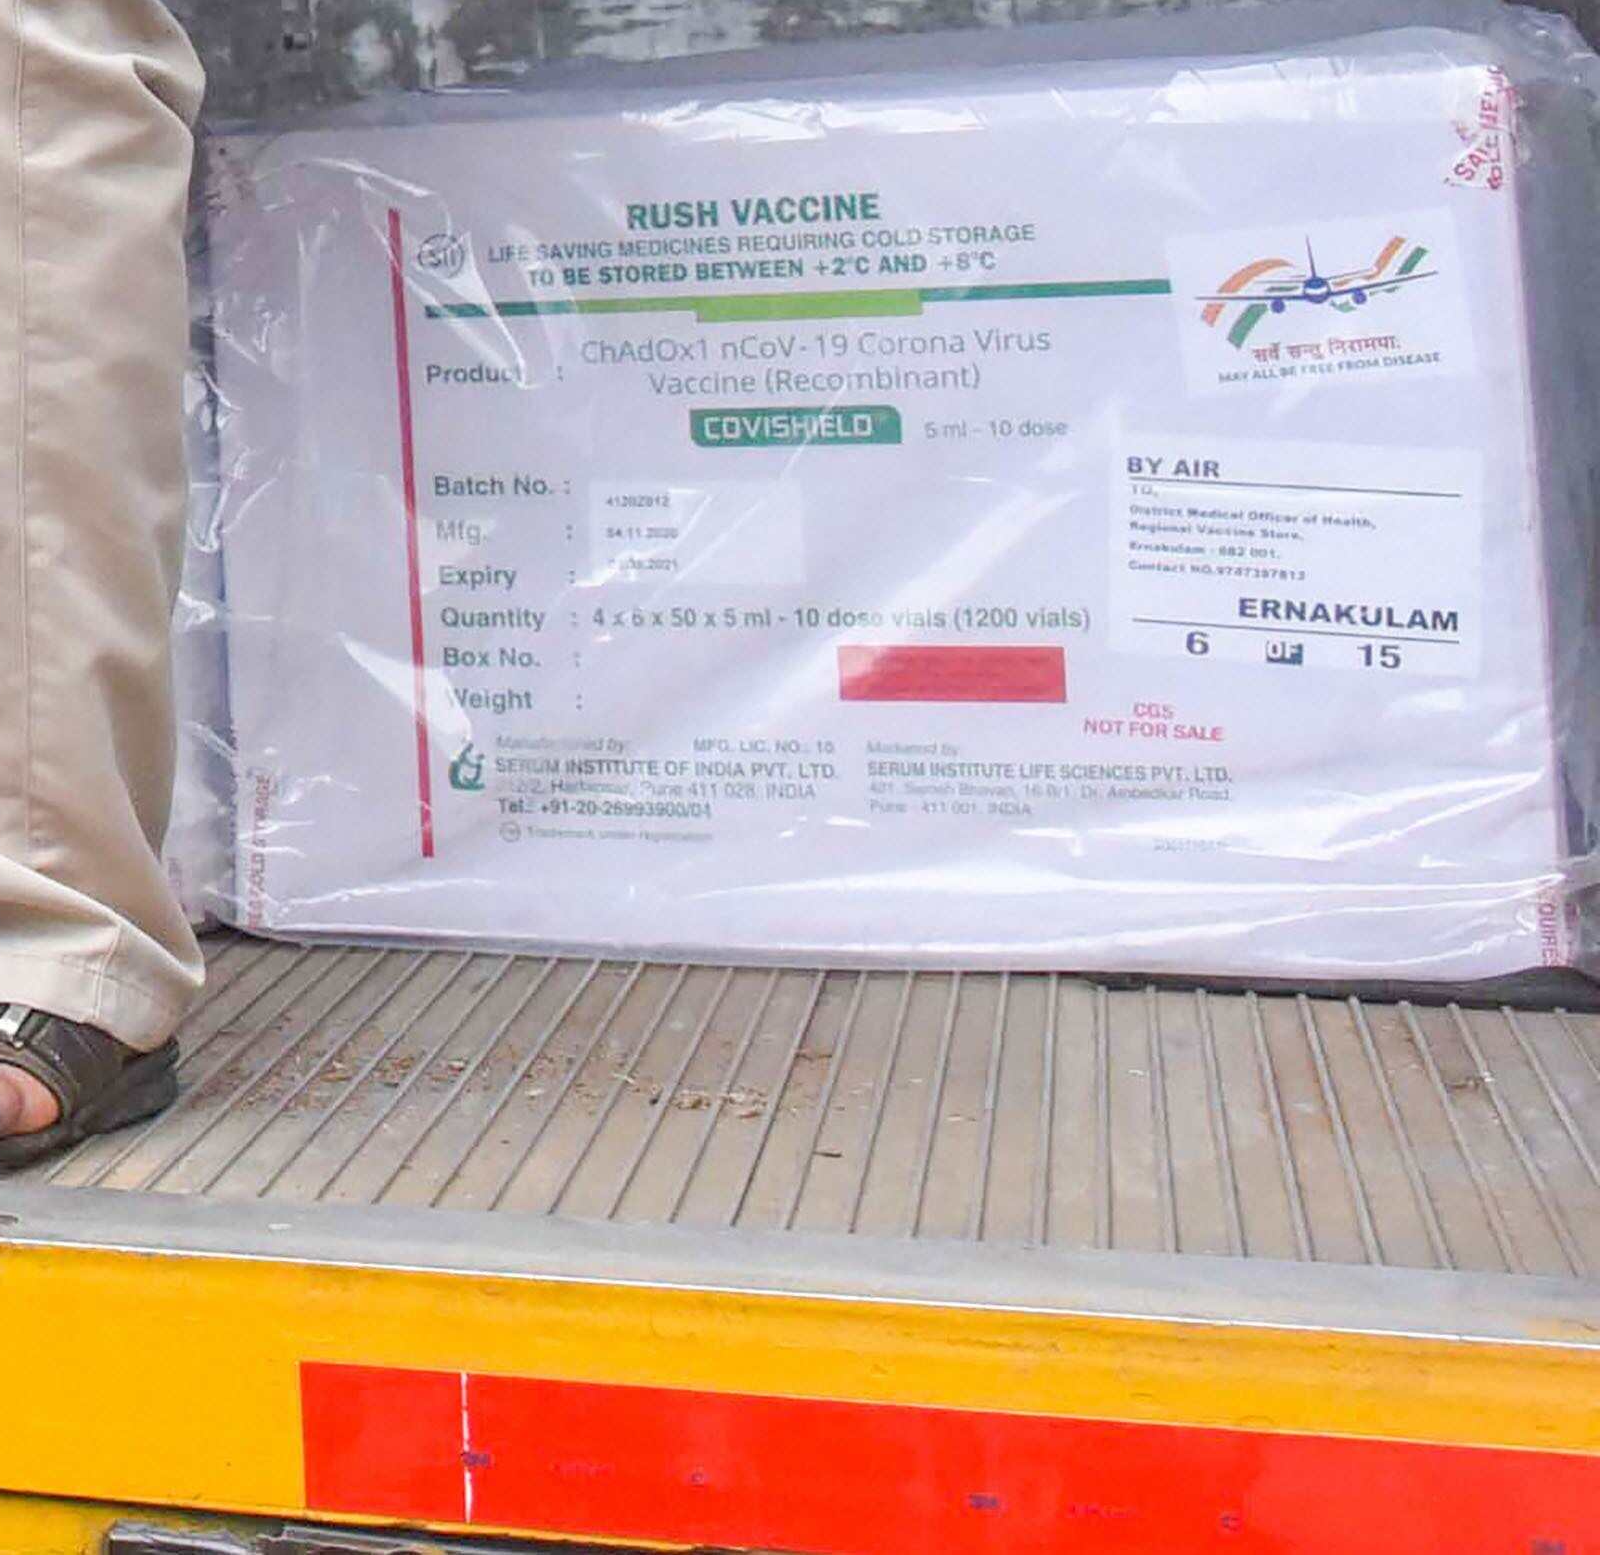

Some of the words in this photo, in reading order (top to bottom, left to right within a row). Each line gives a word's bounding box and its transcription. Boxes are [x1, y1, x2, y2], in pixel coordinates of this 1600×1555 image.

[626, 200, 719, 231] RUSH
[731, 192, 882, 227] VACCINE
[487, 245, 529, 264] LIFE
[536, 241, 613, 261] SAVING
[618, 236, 731, 257] MEDICINES
[737, 230, 856, 253] REQUIRING
[861, 227, 923, 247] COLD
[927, 223, 1037, 245] STORAGE
[529, 268, 554, 286] TO
[563, 265, 591, 285] BE
[598, 263, 687, 284] STORED
[696, 258, 804, 282] BETWEEN
[878, 253, 928, 275] AND
[581, 337, 709, 364] ChAdOx1
[855, 331, 967, 358] Corona
[972, 328, 1052, 353] Virus
[1338, 358, 1380, 372] FROM
[1383, 352, 1441, 368] DISEASE
[649, 371, 757, 396] Vaccine
[764, 363, 981, 396] (Recombinant)
[703, 413, 873, 442] COVISHIELD
[924, 420, 938, 440] 5
[942, 418, 968, 439] ml
[988, 419, 1013, 438] 10
[1017, 417, 1069, 438] dose
[1126, 456, 1163, 476] BY
[1173, 459, 1221, 478] AIR
[434, 475, 505, 497] Batch
[513, 474, 553, 496] No.
[436, 519, 488, 546] Mfg.
[439, 565, 518, 590] Expiry
[440, 606, 546, 632] Quantity
[592, 607, 605, 626] 4
[670, 607, 697, 627] 50
[723, 607, 736, 627] 5
[744, 607, 771, 628] ml
[795, 607, 820, 627] 10
[827, 607, 883, 628] dose
[891, 607, 947, 628] vials
[953, 607, 1018, 633] (1200
[1025, 607, 1092, 632] vials)
[1238, 596, 1459, 633] ERNAKULAM
[442, 647, 491, 667] Box
[499, 648, 541, 668] No.
[1186, 630, 1211, 656] 6
[1265, 640, 1304, 665] OF
[1357, 643, 1402, 669] 15
[1133, 702, 1175, 720] CGS
[1083, 718, 1124, 735] NOT
[1128, 721, 1168, 739] FOR
[1173, 724, 1224, 743] SALE
[496, 758, 559, 775] SERUM
[565, 759, 659, 776] INSTITUTE
[664, 760, 690, 777] OF
[695, 761, 745, 778] INDIA
[751, 762, 792, 779] PVT.
[867, 761, 925, 777] SERUM
[930, 762, 1015, 779] INSTITUTE
[1019, 763, 1056, 779] LIFE
[1060, 764, 1147, 781] SCIENCES
[1151, 765, 1191, 782] PVT.
[1194, 766, 1232, 783] LTD.
